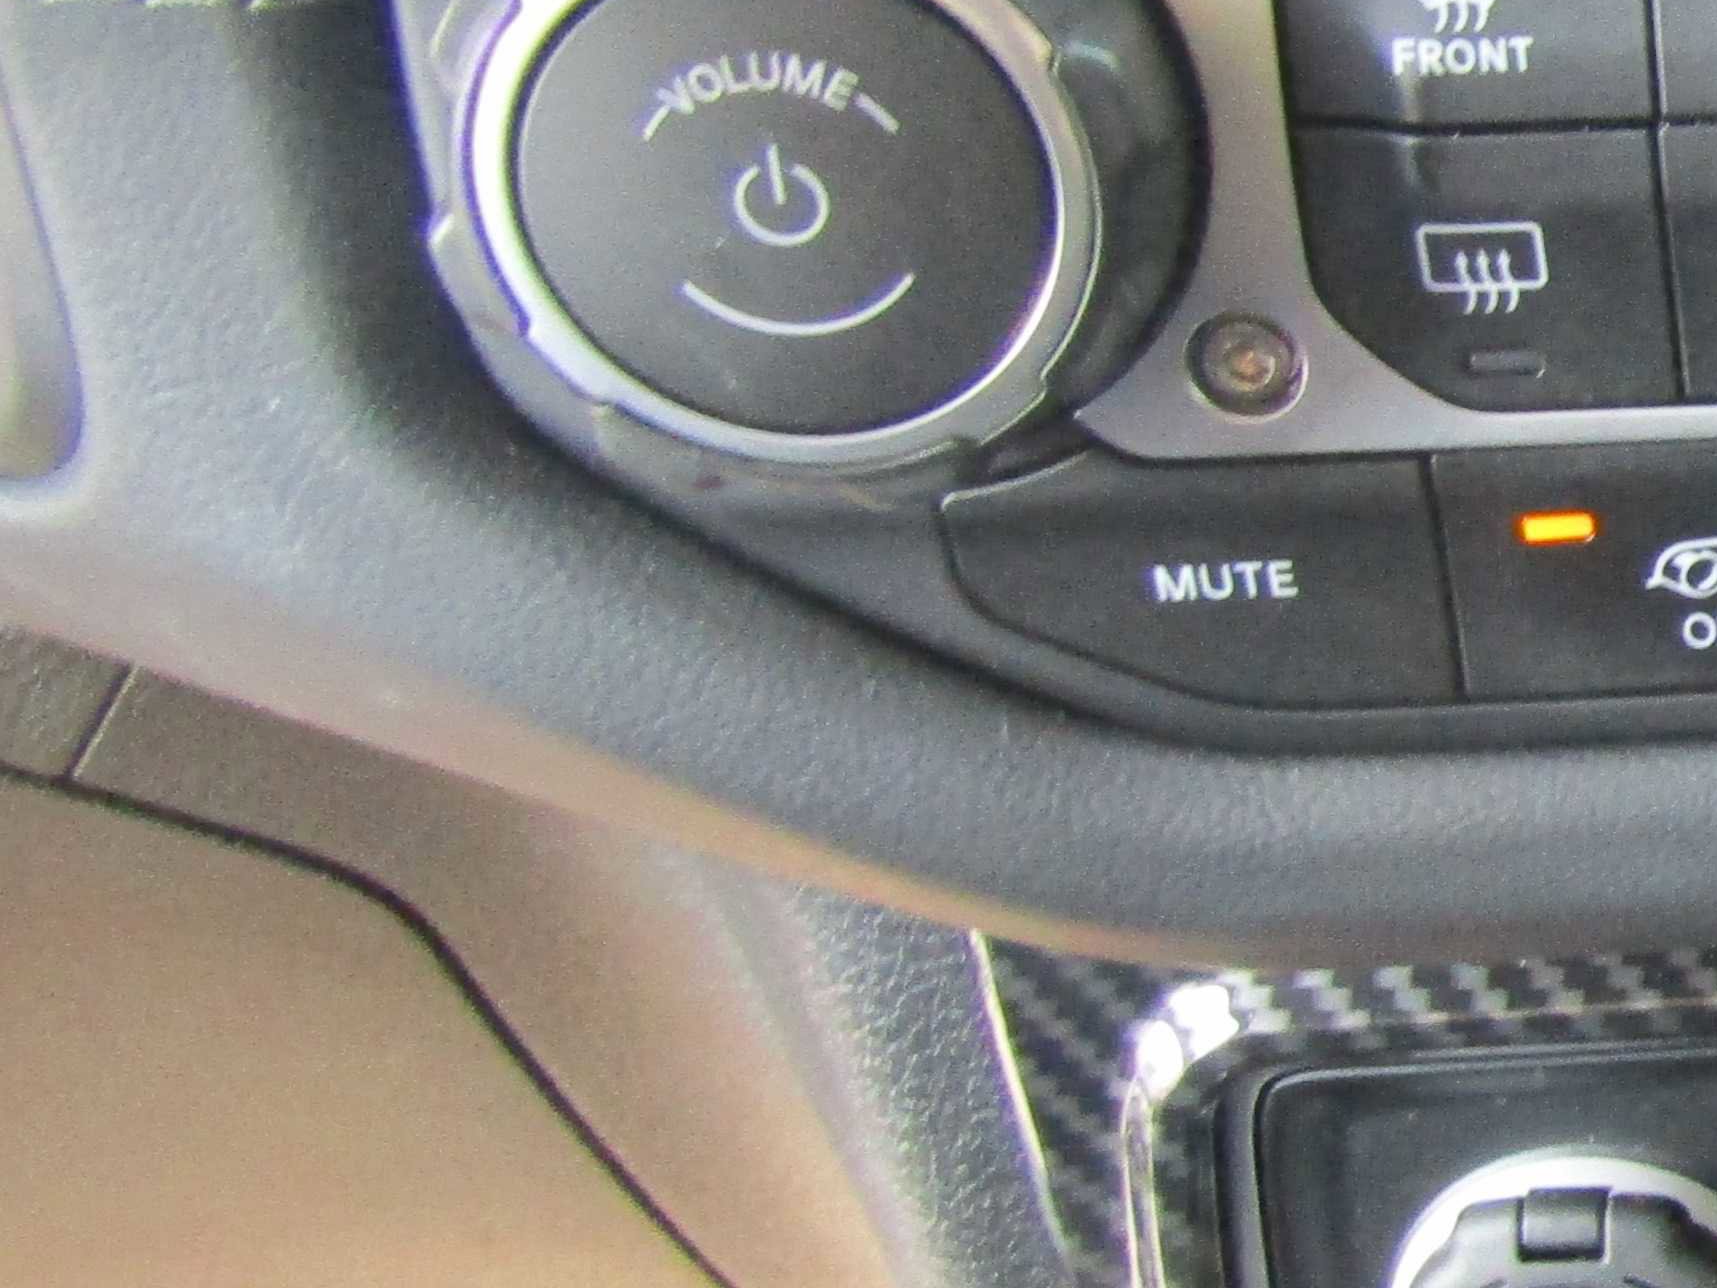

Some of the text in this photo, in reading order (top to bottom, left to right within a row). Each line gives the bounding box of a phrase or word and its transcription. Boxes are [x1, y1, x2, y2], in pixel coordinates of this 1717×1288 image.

[1391, 35, 1534, 76] FRONT
[659, 52, 860, 114] VOLUME
[1153, 558, 1299, 604] MUTE
